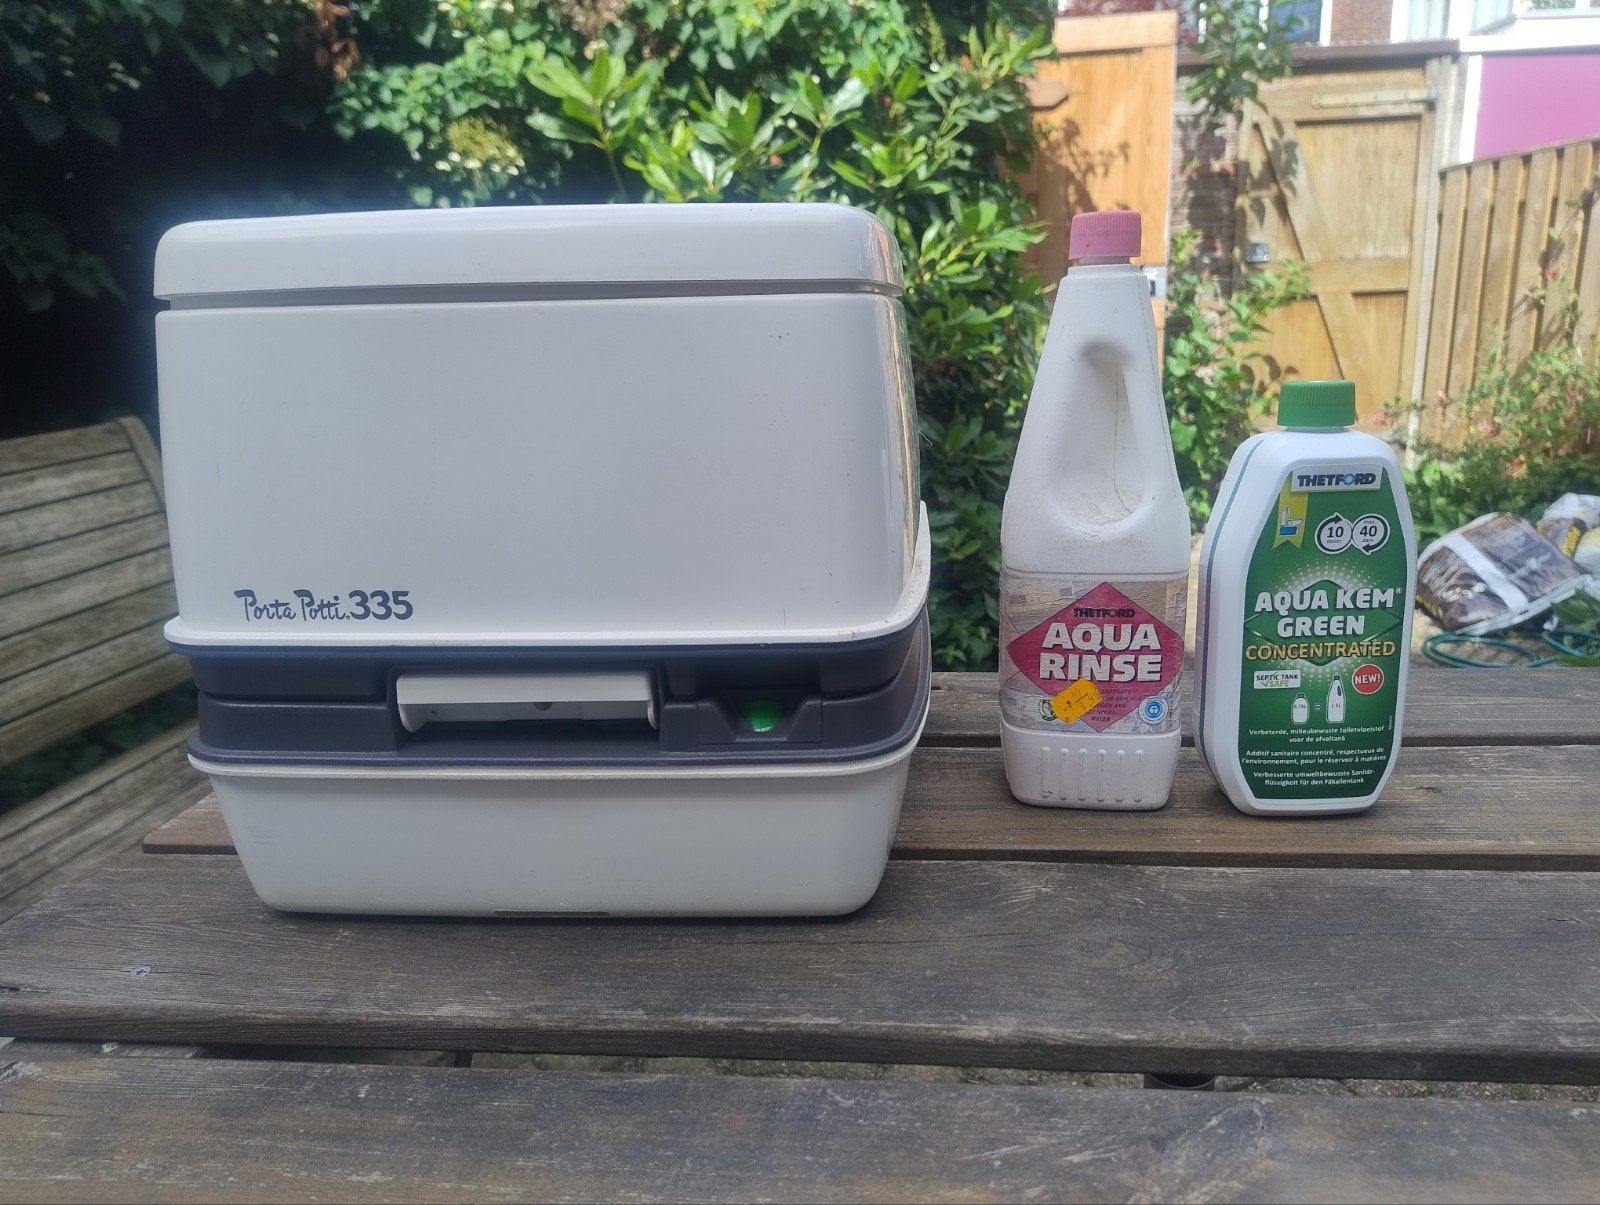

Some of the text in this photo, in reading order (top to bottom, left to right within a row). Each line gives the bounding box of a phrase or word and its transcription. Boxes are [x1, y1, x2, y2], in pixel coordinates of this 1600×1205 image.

[1297, 472, 1376, 487] THETFORD
[1327, 526, 1344, 538] 10
[1359, 525, 1378, 537] 40
[234, 589, 297, 622] Porta
[348, 589, 414, 621] 335
[1254, 589, 1329, 616] AQUA
[1073, 608, 1136, 618] THETFORD
[1277, 615, 1365, 638] GREEN
[1041, 622, 1162, 653] AQUA
[1245, 641, 1396, 661] CONCENTRATED
[1039, 652, 1162, 682] RINSE
[1269, 680, 1290, 688] SAFE
[1354, 673, 1381, 685] NEW!
[1249, 728, 1289, 736] Verbeterde,
[1340, 725, 1384, 733] toiletvloeistof
[1336, 748, 1375, 757] respectueux
[1360, 754, 1387, 762] matières
[1264, 779, 1299, 787] flüssigkeit
[1324, 777, 1365, 785] Fäkalientank
